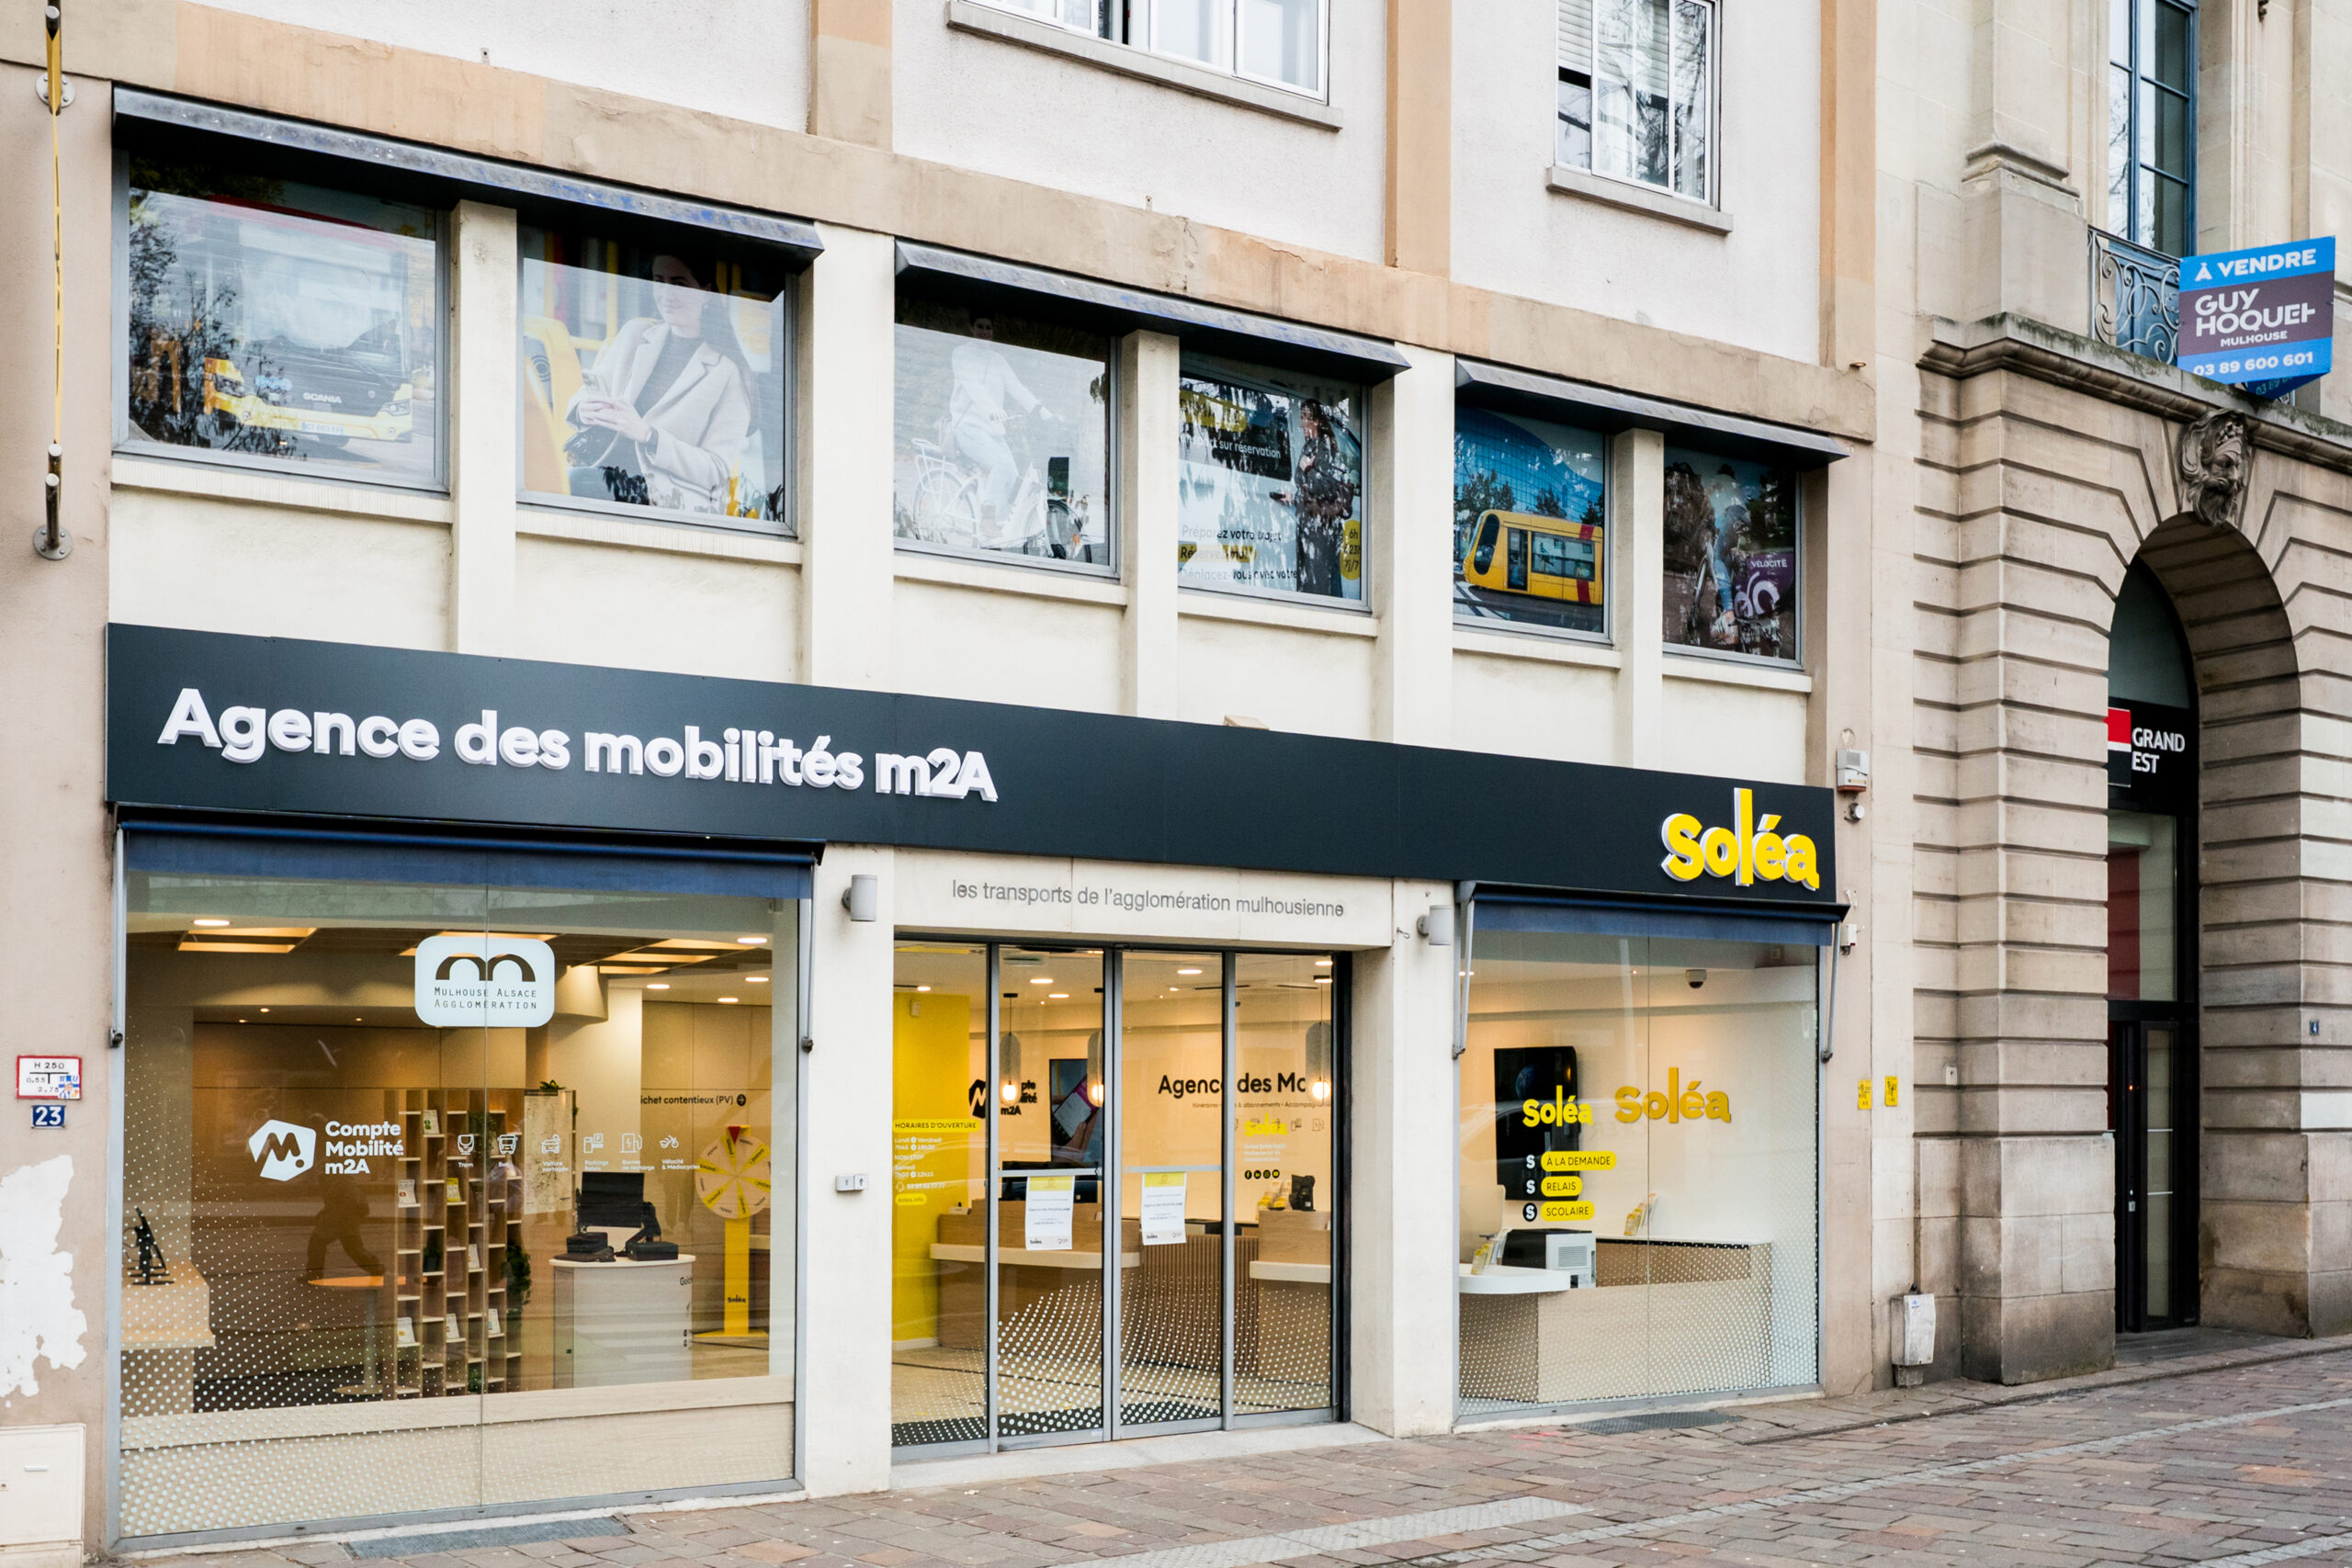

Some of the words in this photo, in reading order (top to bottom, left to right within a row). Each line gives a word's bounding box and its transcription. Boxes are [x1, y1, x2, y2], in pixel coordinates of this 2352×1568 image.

[2195, 263, 2212, 281] À
[2217, 248, 2317, 277] VENDRE
[2195, 288, 2259, 316] GUY
[2196, 302, 2315, 337] HOQUET
[2221, 331, 2288, 347] MULHOUSE
[2193, 364, 2215, 377] 03
[2219, 360, 2241, 374] 89
[2245, 355, 2279, 371] 600
[2282, 352, 2313, 367] 601
[302, 391, 343, 404] SCANIA
[1219, 440, 1233, 451] sur
[1234, 441, 1281, 459] réservation
[157, 688, 440, 763] Agence
[454, 709, 571, 770] des
[584, 725, 864, 790] mobilités
[876, 747, 999, 802] m2A
[2132, 727, 2186, 752] GRAND
[2132, 750, 2160, 773] EST
[1660, 787, 1820, 891] Soléa
[953, 879, 978, 899] les
[982, 882, 1073, 905] transports
[1077, 885, 1099, 905] de
[1104, 886, 1231, 912] l'agglomération
[1236, 897, 1344, 917] mulhousienne
[434, 987, 489, 997] MULHOUSE
[496, 987, 537, 998] ALSACE
[1158, 1075, 1223, 1100] Agenc
[1237, 1072, 1272, 1093] des
[1614, 1066, 1731, 1123] Soléa
[640, 1095, 662, 1104] ichet
[663, 1096, 714, 1105] contentieux
[716, 1095, 733, 1105] (PV)
[1001, 1105, 1022, 1115] m2A
[1522, 1084, 1593, 1127] Soléa
[35, 1106, 62, 1126] 23
[325, 1121, 401, 1140] Compte
[325, 1139, 404, 1157] Mobilité
[325, 1158, 370, 1175] m2A
[1546, 1156, 1553, 1166] À
[1555, 1157, 1566, 1166] LA
[1568, 1156, 1611, 1166] DEMANDE
[1546, 1181, 1577, 1191] RELAIS
[1525, 1204, 1535, 1220] S
[1546, 1206, 1589, 1217] SCOLAIRE
